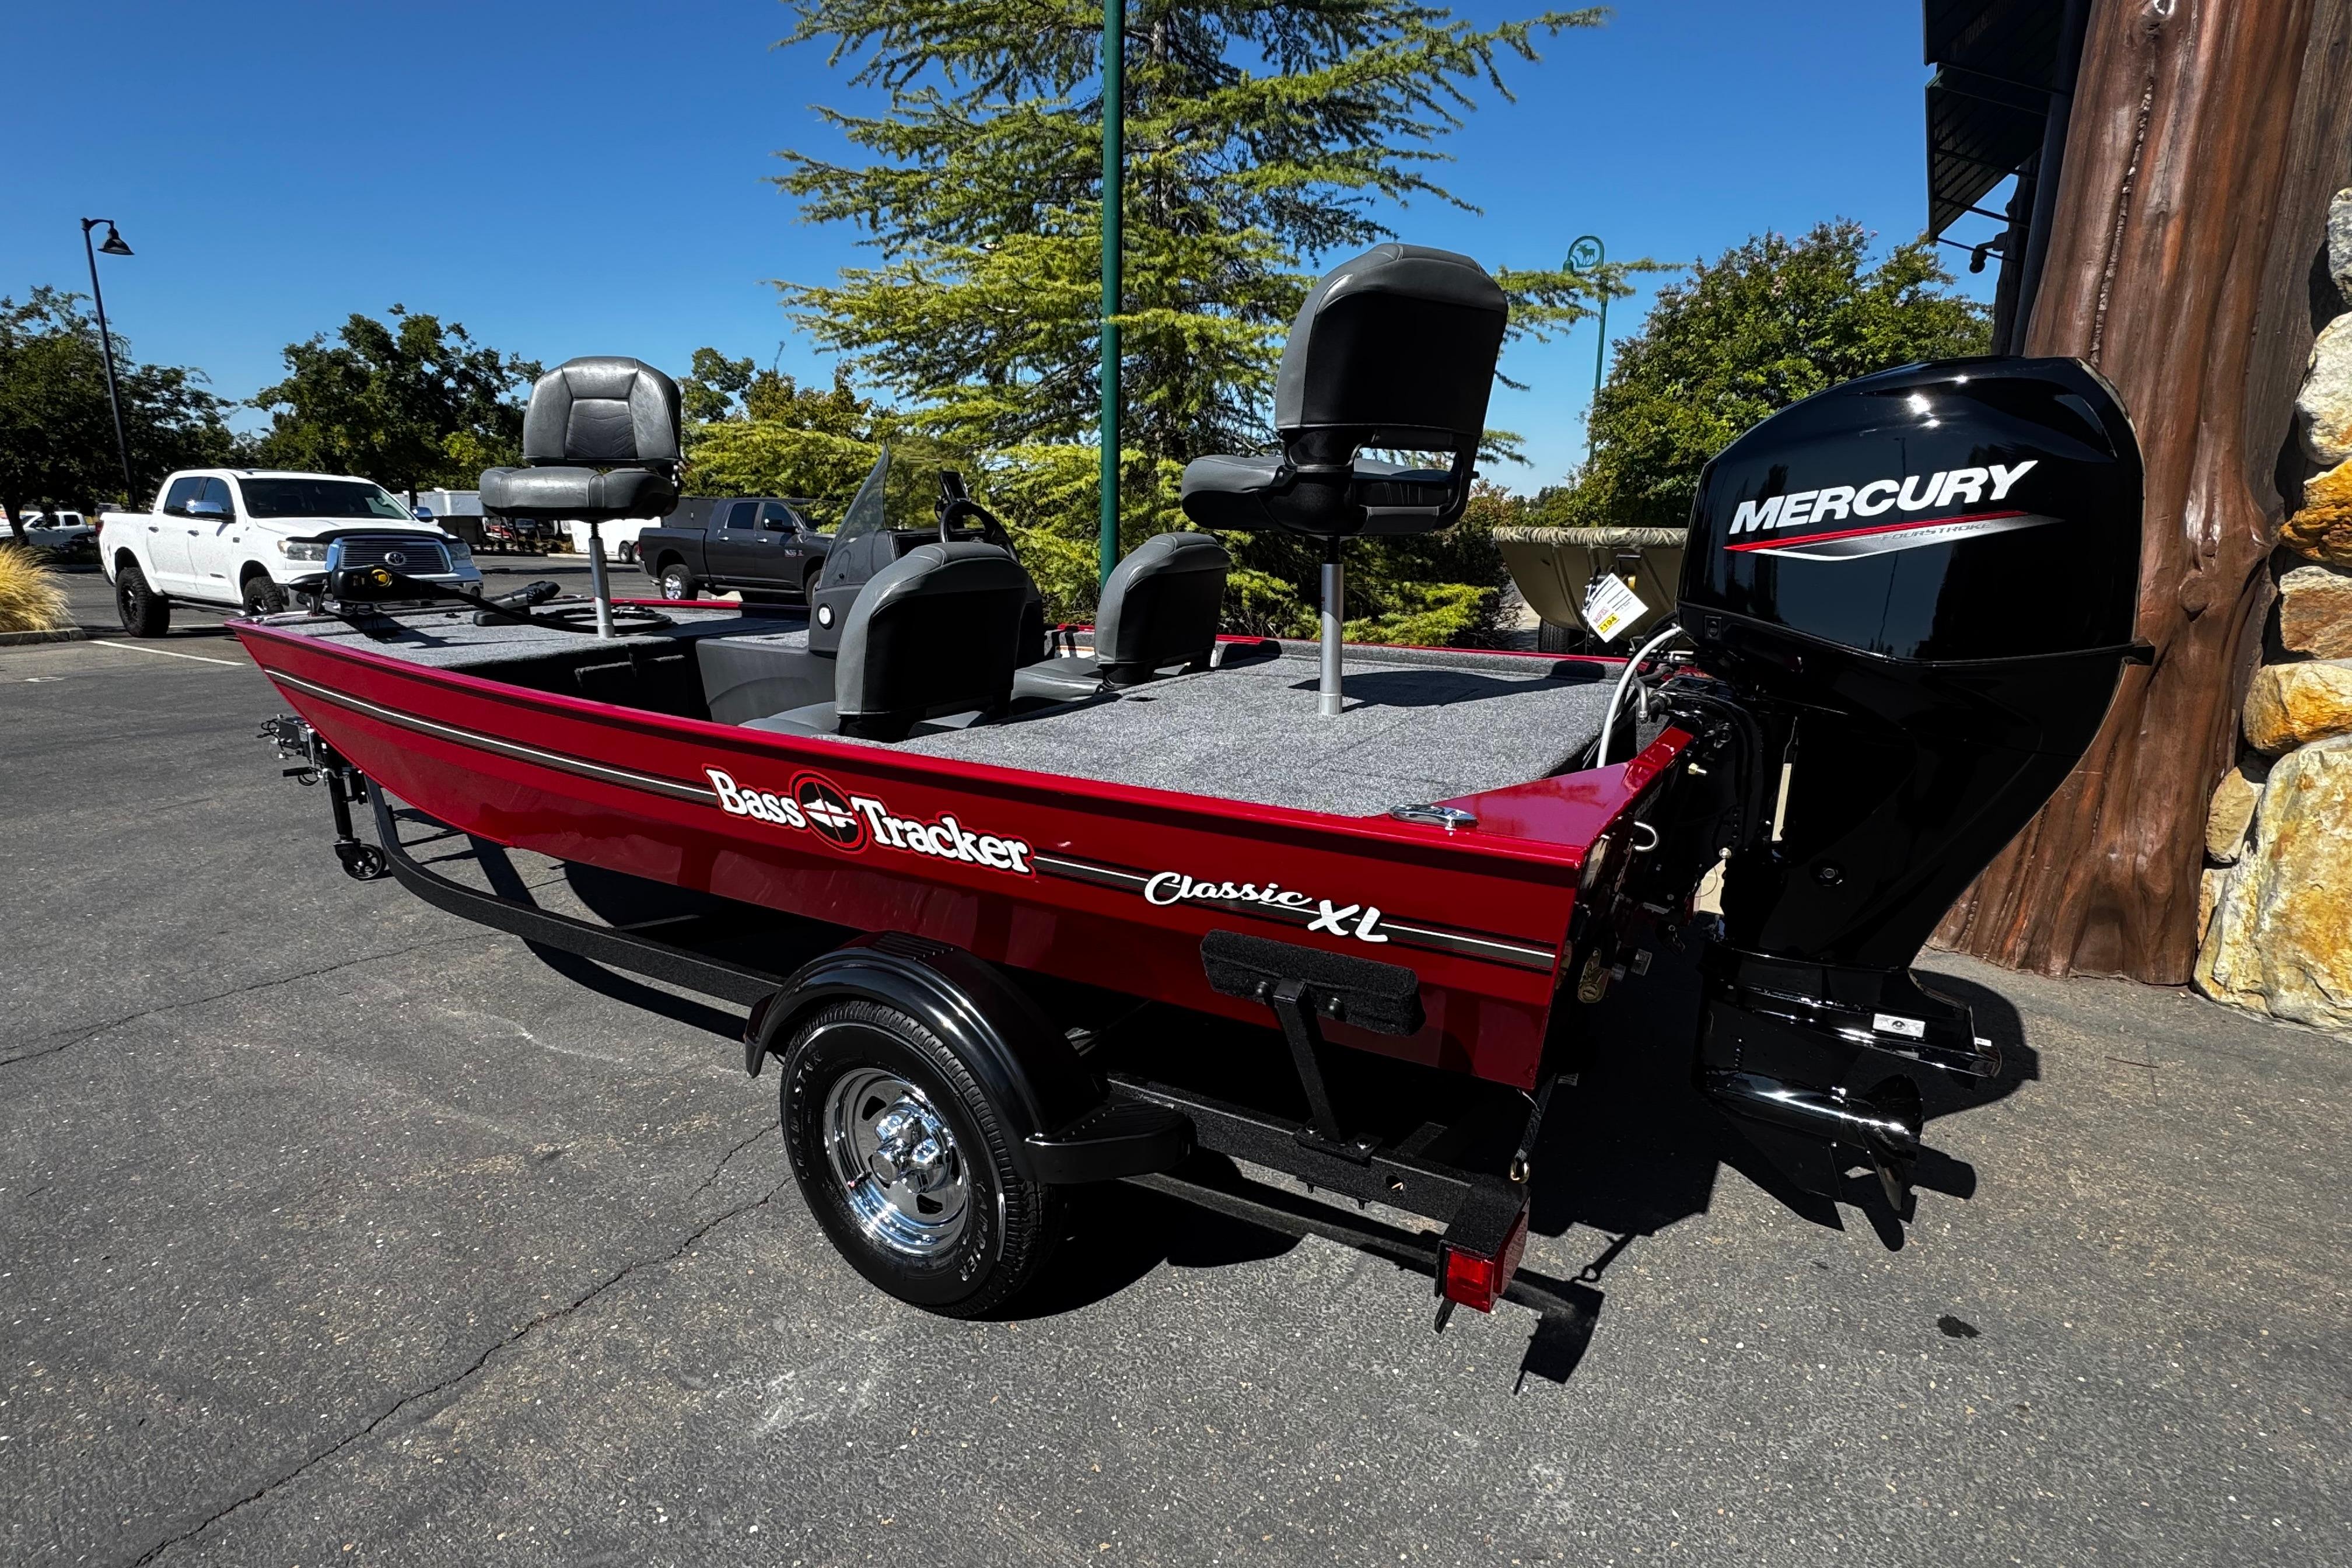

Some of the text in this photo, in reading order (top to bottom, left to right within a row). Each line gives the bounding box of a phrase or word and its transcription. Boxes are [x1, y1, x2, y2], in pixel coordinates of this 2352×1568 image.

[1728, 460, 2038, 536] MERCURY
[1881, 522, 1991, 541] FOURSTROKE
[705, 769, 1030, 874] Bass Tracker
[1144, 872, 1388, 943] Classic XL
